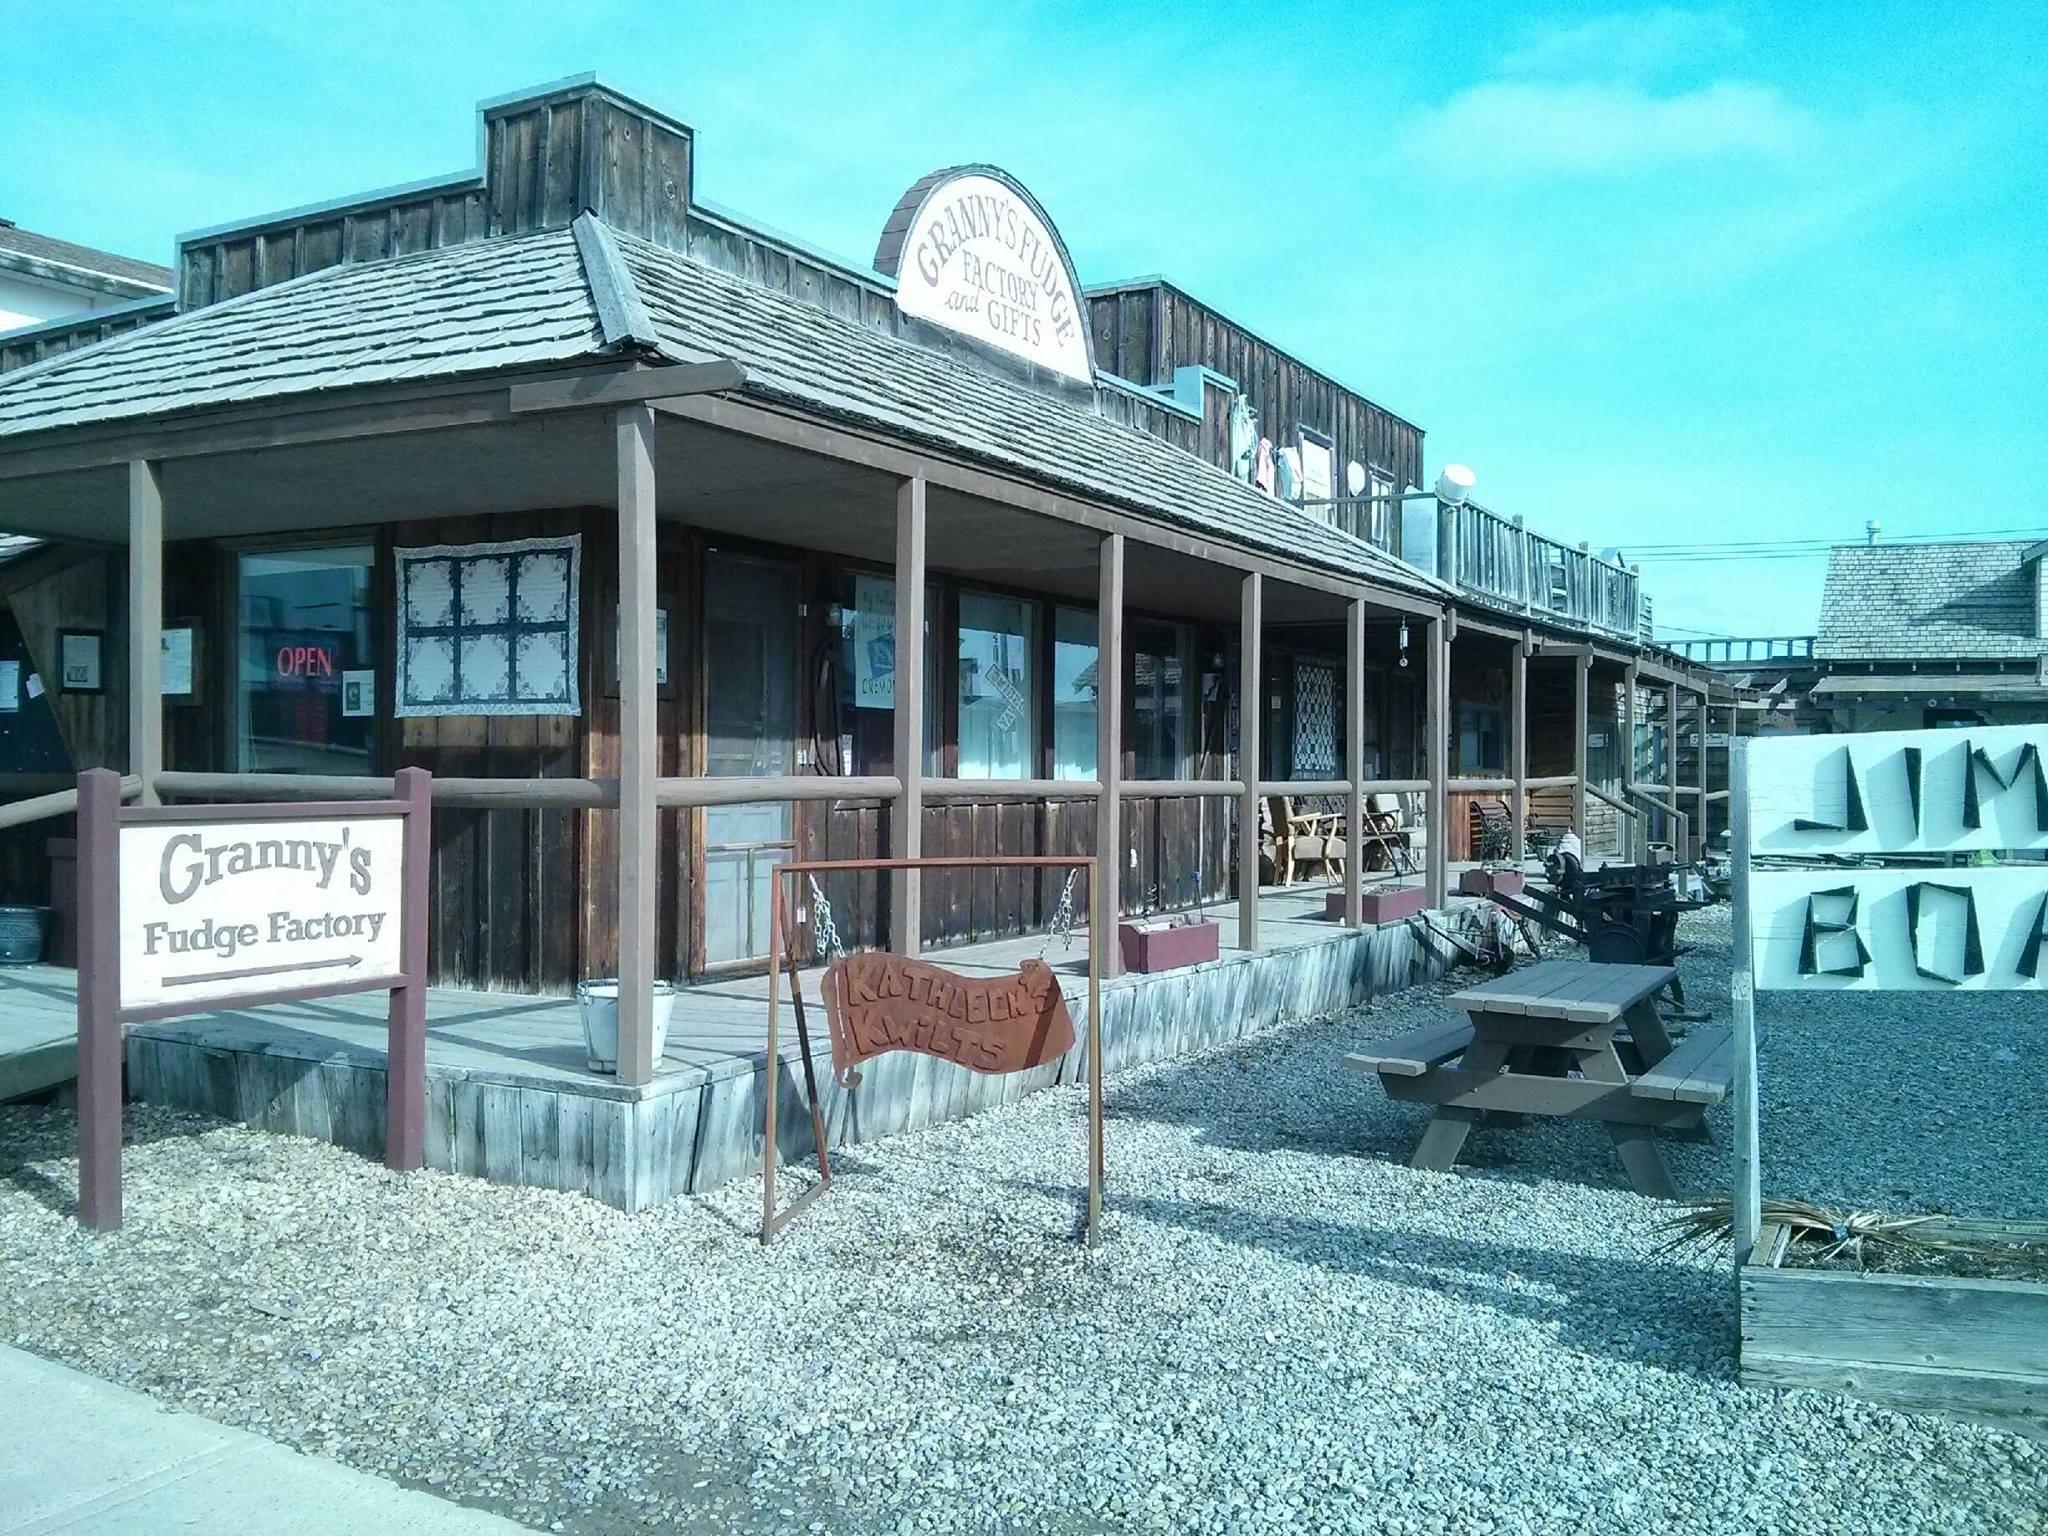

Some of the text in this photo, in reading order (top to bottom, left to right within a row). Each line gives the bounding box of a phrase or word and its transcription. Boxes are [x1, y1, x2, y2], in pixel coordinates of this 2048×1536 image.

[918, 194, 1074, 348] GRANNY'S FUDGE
[962, 248, 1040, 311] FACTORY
[944, 290, 1041, 347] and GIFTS
[277, 646, 332, 677] OPEN
[861, 678, 896, 695] CREMO
[159, 827, 372, 904] Granny's
[143, 911, 387, 959] Fudge Factory
[845, 961, 1056, 1023] KATHLEEN'S
